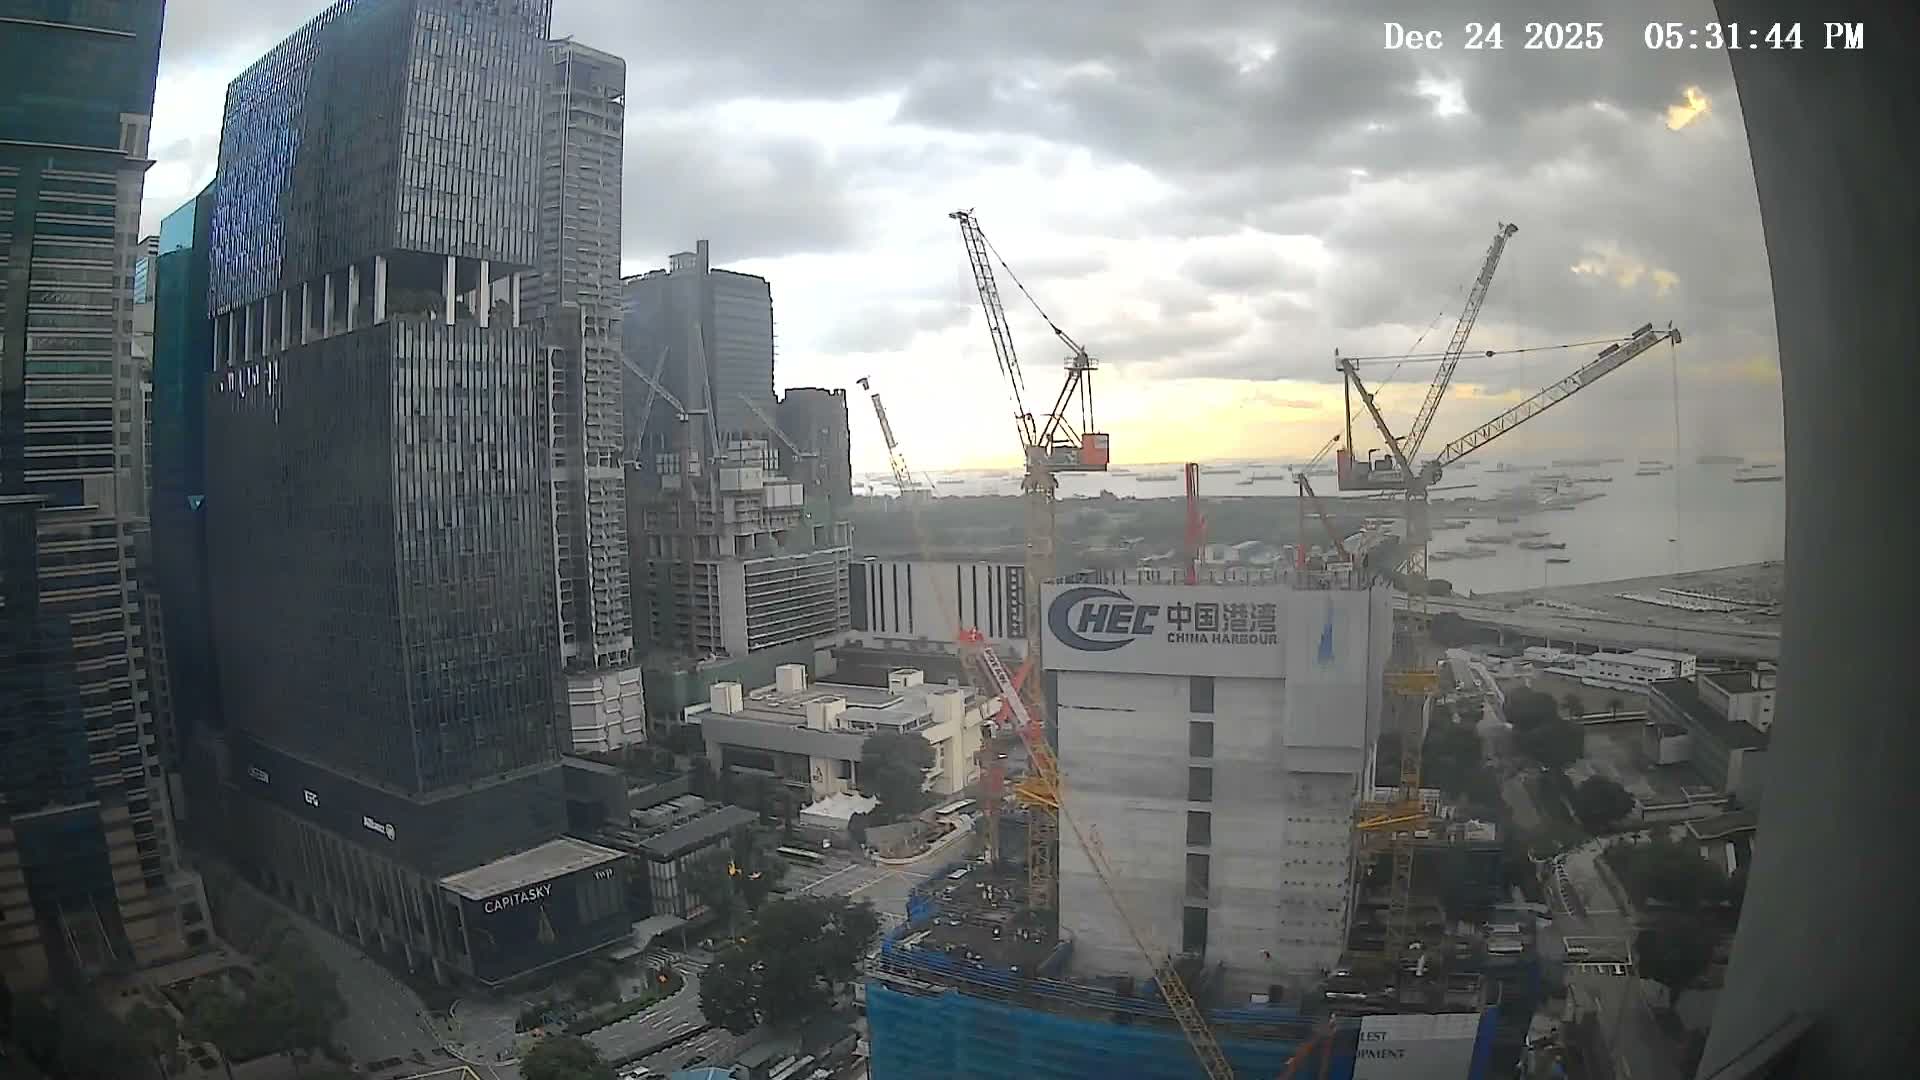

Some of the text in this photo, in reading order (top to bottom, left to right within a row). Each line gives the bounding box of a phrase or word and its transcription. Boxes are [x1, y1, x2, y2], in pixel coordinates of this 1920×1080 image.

[1167, 601, 1278, 633] 中国港湾
[1167, 632, 1278, 645] CHINA HARBOUR
[484, 883, 552, 913] CAPITASKY
